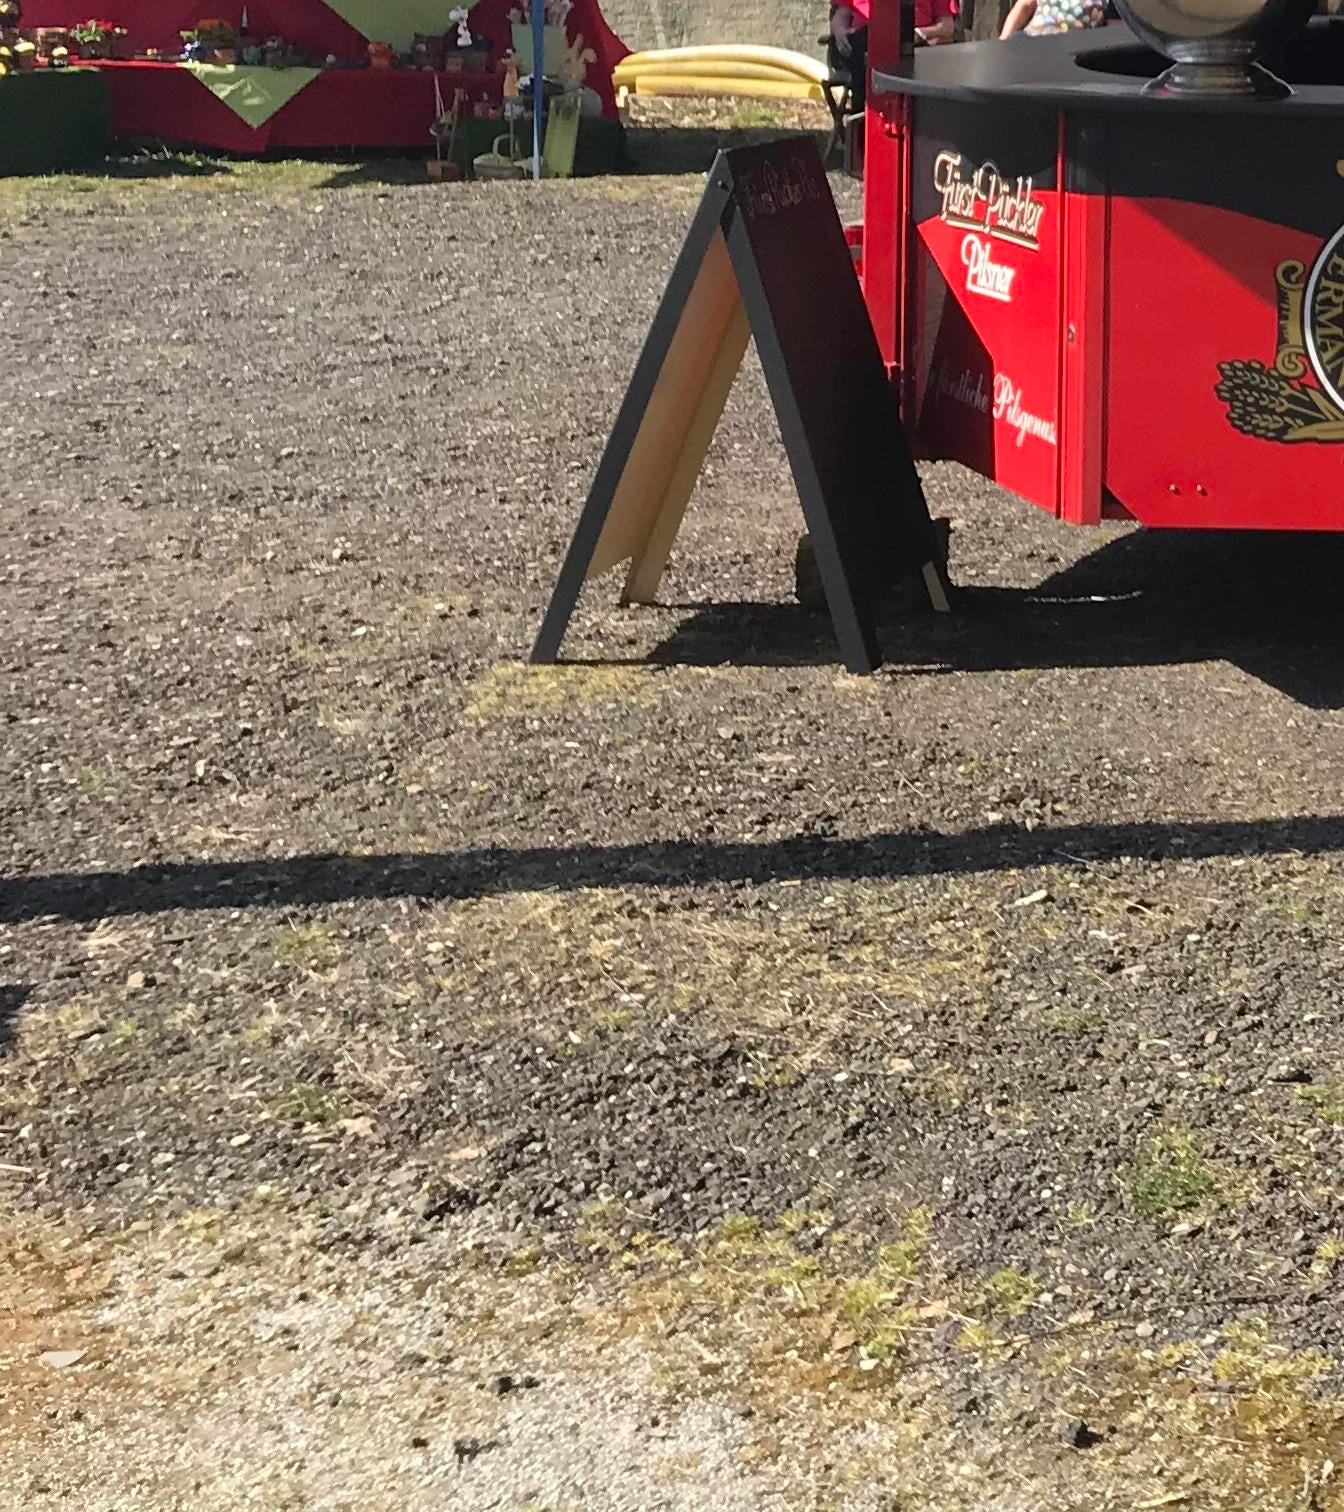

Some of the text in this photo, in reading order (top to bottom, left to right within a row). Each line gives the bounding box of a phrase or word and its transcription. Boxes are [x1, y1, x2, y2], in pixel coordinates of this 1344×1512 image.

[934, 149, 1045, 237] Fürst Pückler
[961, 233, 1016, 295] Pilsner
